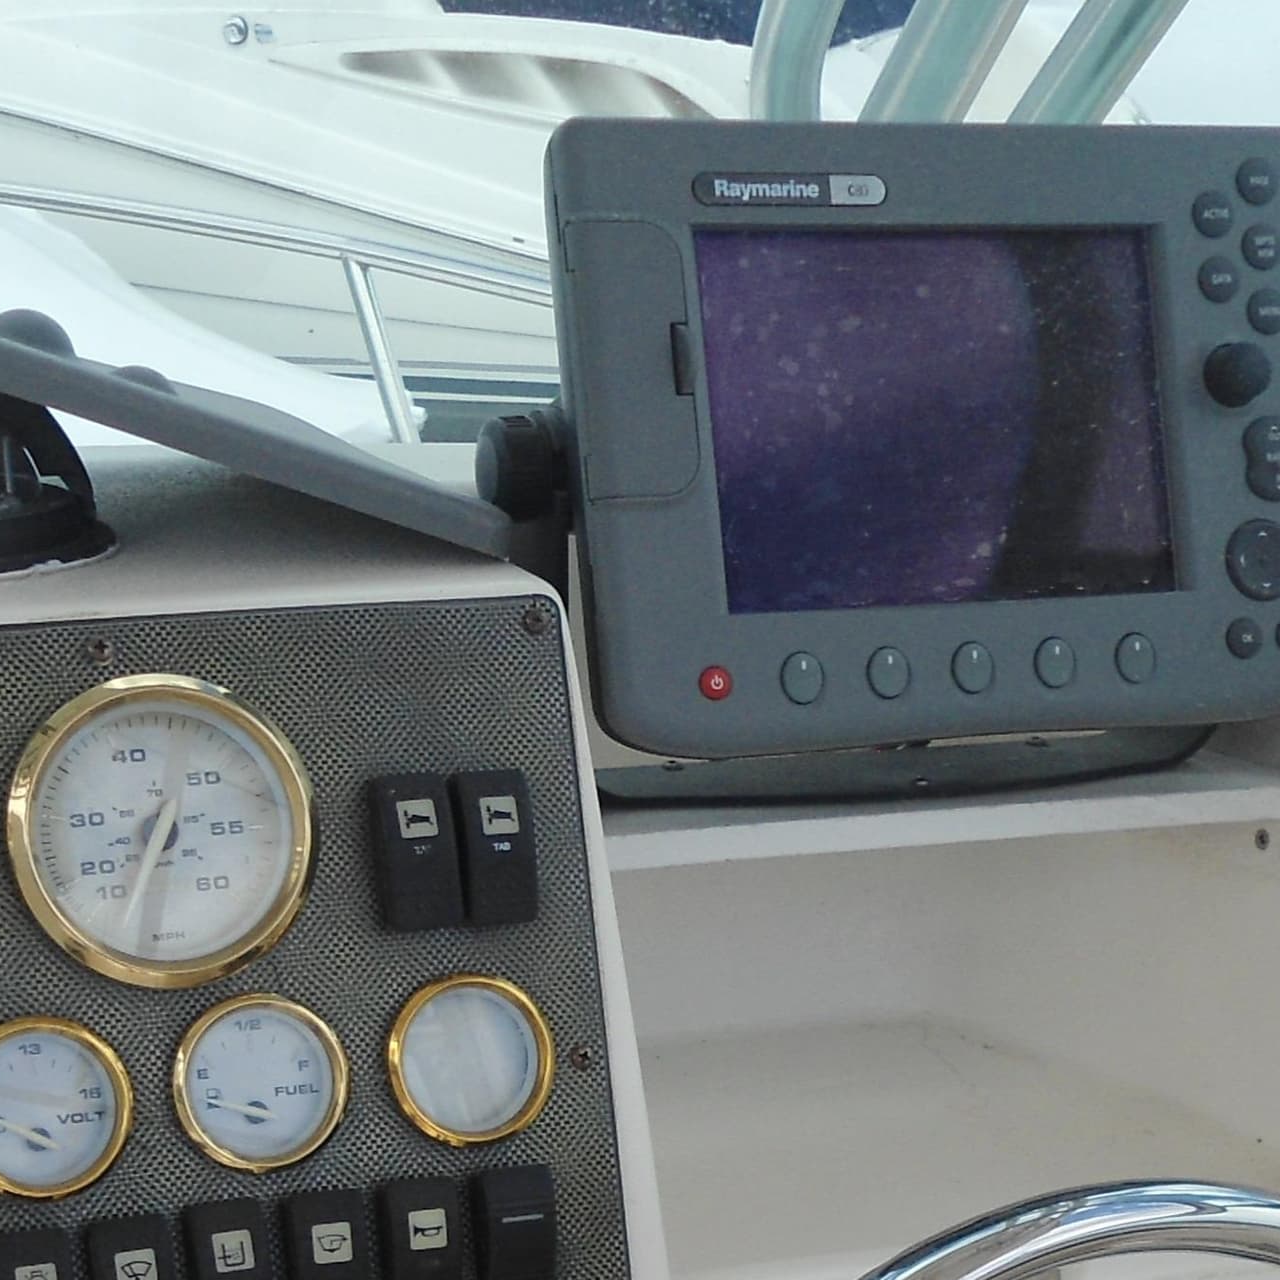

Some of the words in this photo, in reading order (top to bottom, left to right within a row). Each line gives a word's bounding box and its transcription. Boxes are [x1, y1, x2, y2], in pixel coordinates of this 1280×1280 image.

[713, 178, 820, 201] Raymarine
[111, 748, 146, 763] 40
[185, 770, 222, 786] 50
[69, 812, 105, 828] 30
[210, 820, 244, 836] 55
[80, 859, 116, 876] 20
[196, 875, 230, 891] 60
[95, 884, 128, 900] 10
[151, 931, 187, 942] MPH
[234, 1019, 262, 1031] 1/2
[18, 1043, 41, 1056] 13
[297, 1060, 310, 1072] F
[197, 1068, 209, 1080] E
[274, 1083, 320, 1097] FUEL
[56, 1111, 105, 1125] VOLT
